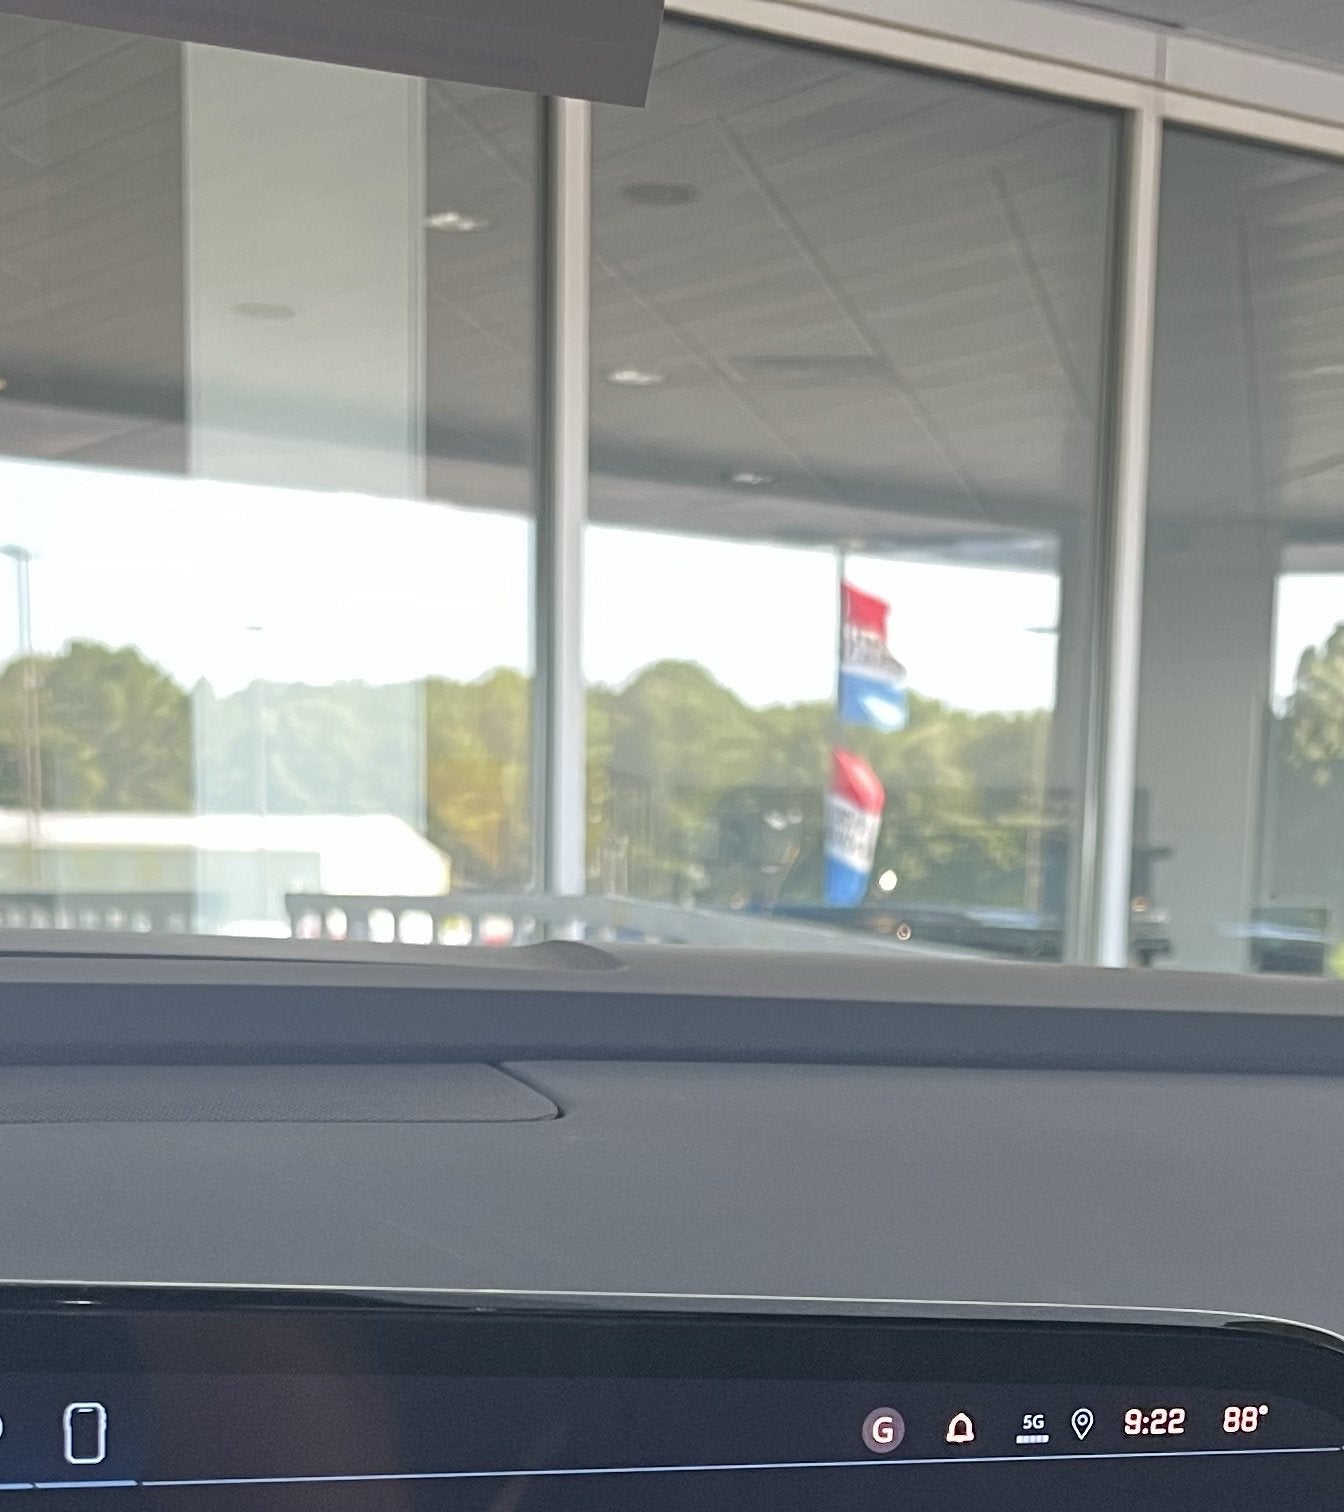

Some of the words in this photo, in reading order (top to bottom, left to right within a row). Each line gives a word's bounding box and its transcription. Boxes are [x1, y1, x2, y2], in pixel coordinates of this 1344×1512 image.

[872, 1416, 894, 1444] G
[1022, 1414, 1045, 1430] 5G
[1124, 1408, 1186, 1435] 9:22
